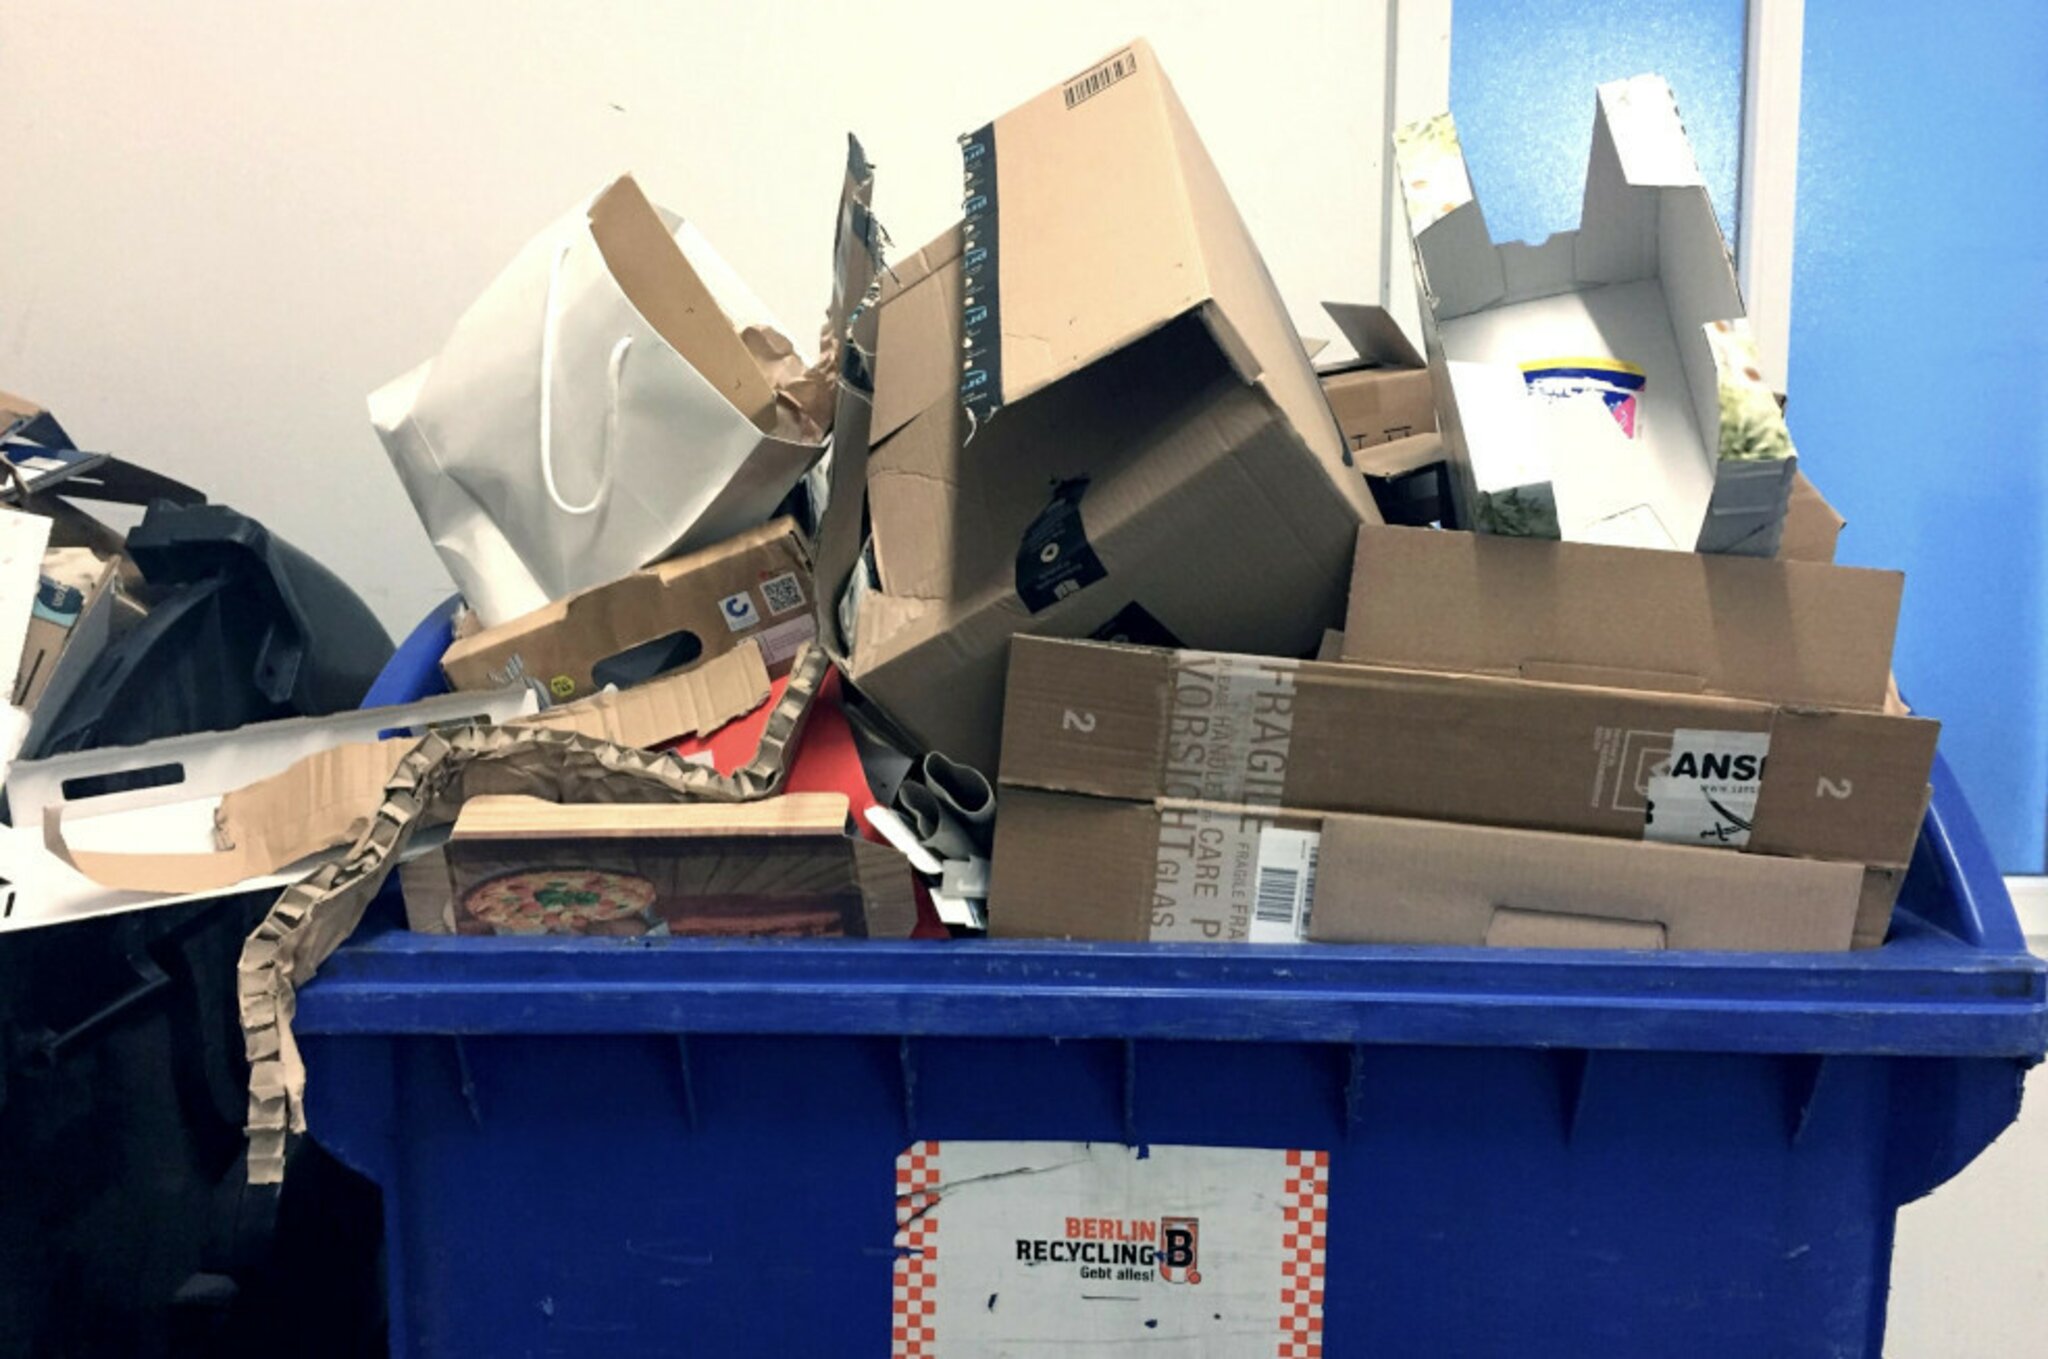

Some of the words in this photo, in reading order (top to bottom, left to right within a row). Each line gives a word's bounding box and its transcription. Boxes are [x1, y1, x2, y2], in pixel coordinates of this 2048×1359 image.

[1063, 709, 1096, 733] 2
[1204, 715, 1231, 795] HANDLE
[1239, 663, 1300, 833] FRAGILE
[1816, 777, 1852, 799] 2
[1193, 827, 1224, 898] CARE
[1232, 842, 1249, 898] FRAGILE
[1151, 860, 1181, 928] GLAS
[1065, 1217, 1156, 1241] BERLIN
[1166, 1229, 1193, 1268] B
[1016, 1240, 1155, 1265] RECYCLING
[1080, 1266, 1112, 1280] Gebt
[1116, 1267, 1155, 1282] alles!
